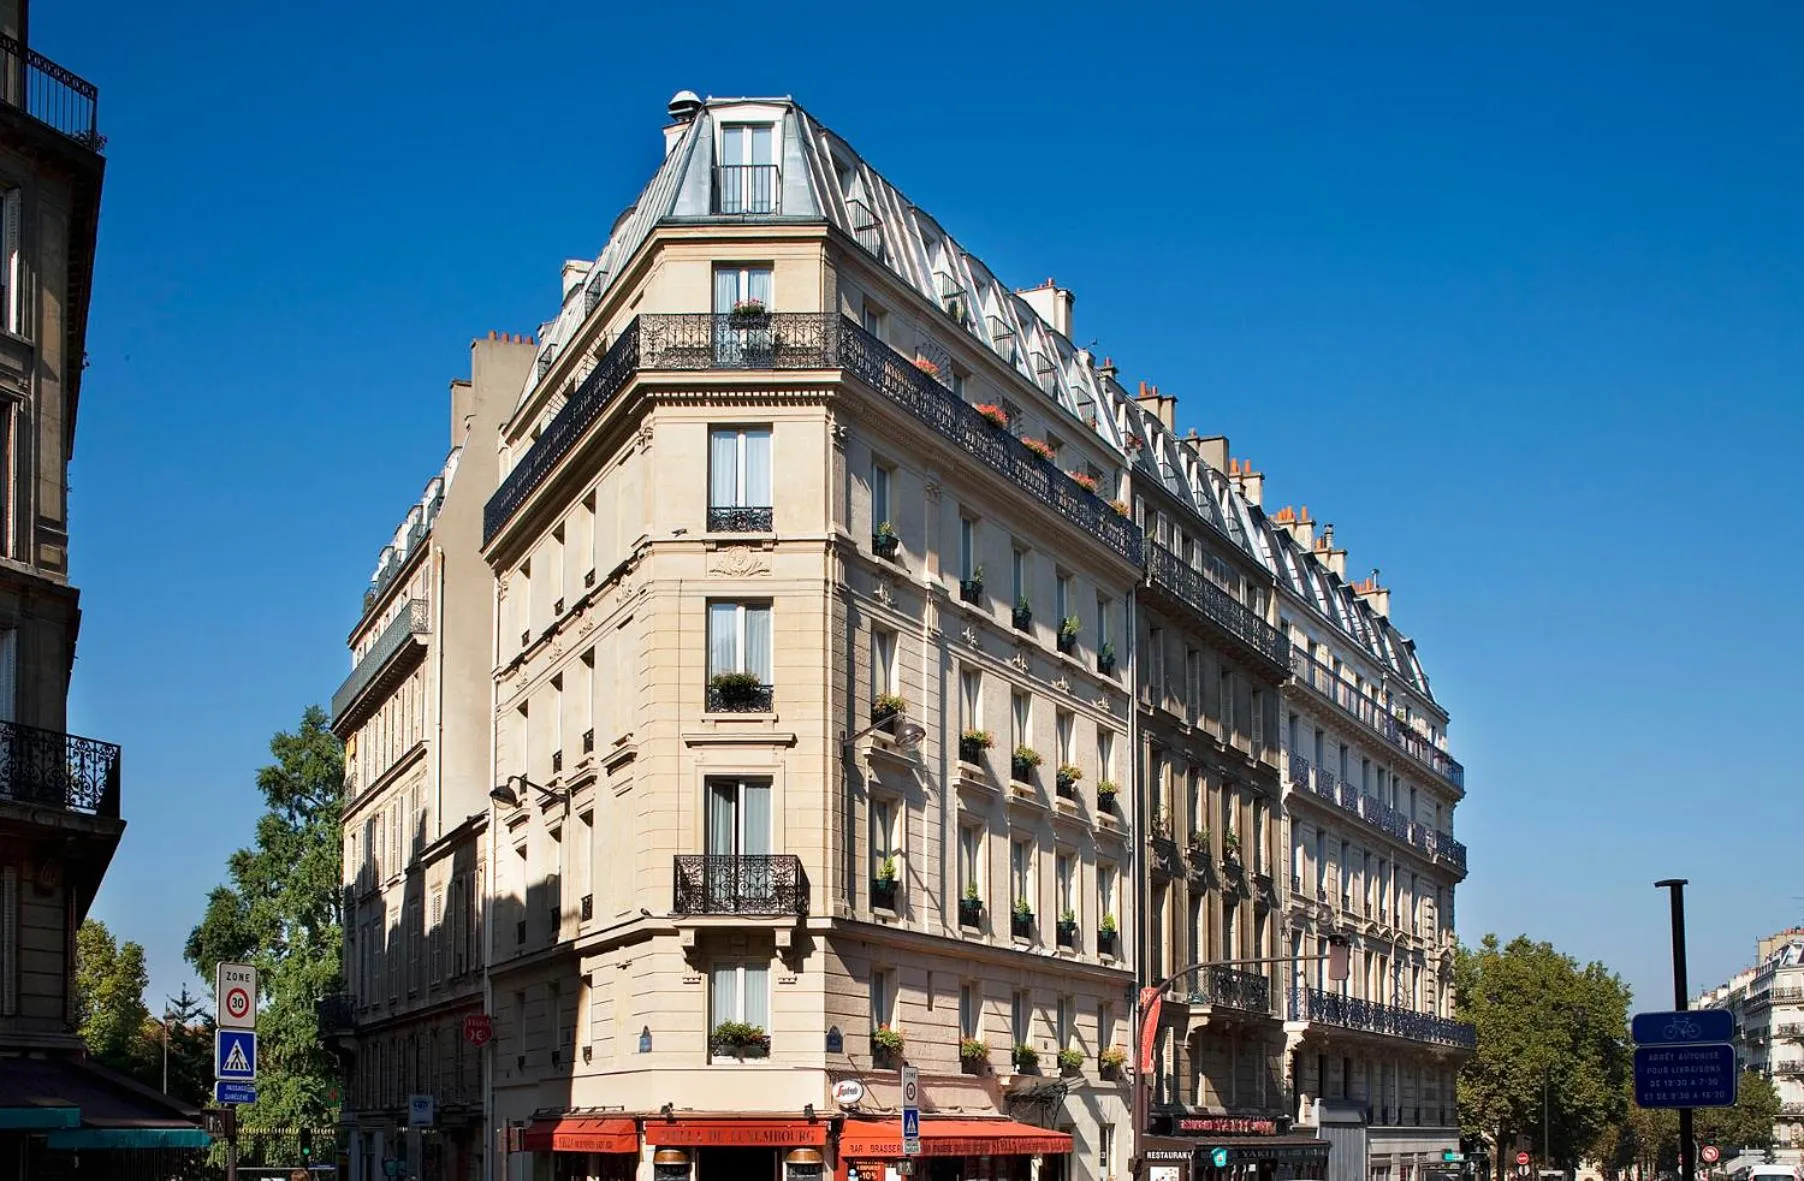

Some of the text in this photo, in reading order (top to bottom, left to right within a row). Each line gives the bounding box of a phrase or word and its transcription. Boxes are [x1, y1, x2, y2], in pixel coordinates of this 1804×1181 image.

[226, 971, 250, 983] ZONE
[231, 997, 244, 1009] 30
[870, 1144, 904, 1153] BRASSERI
[1146, 1151, 1191, 1159] RESTAURANT
